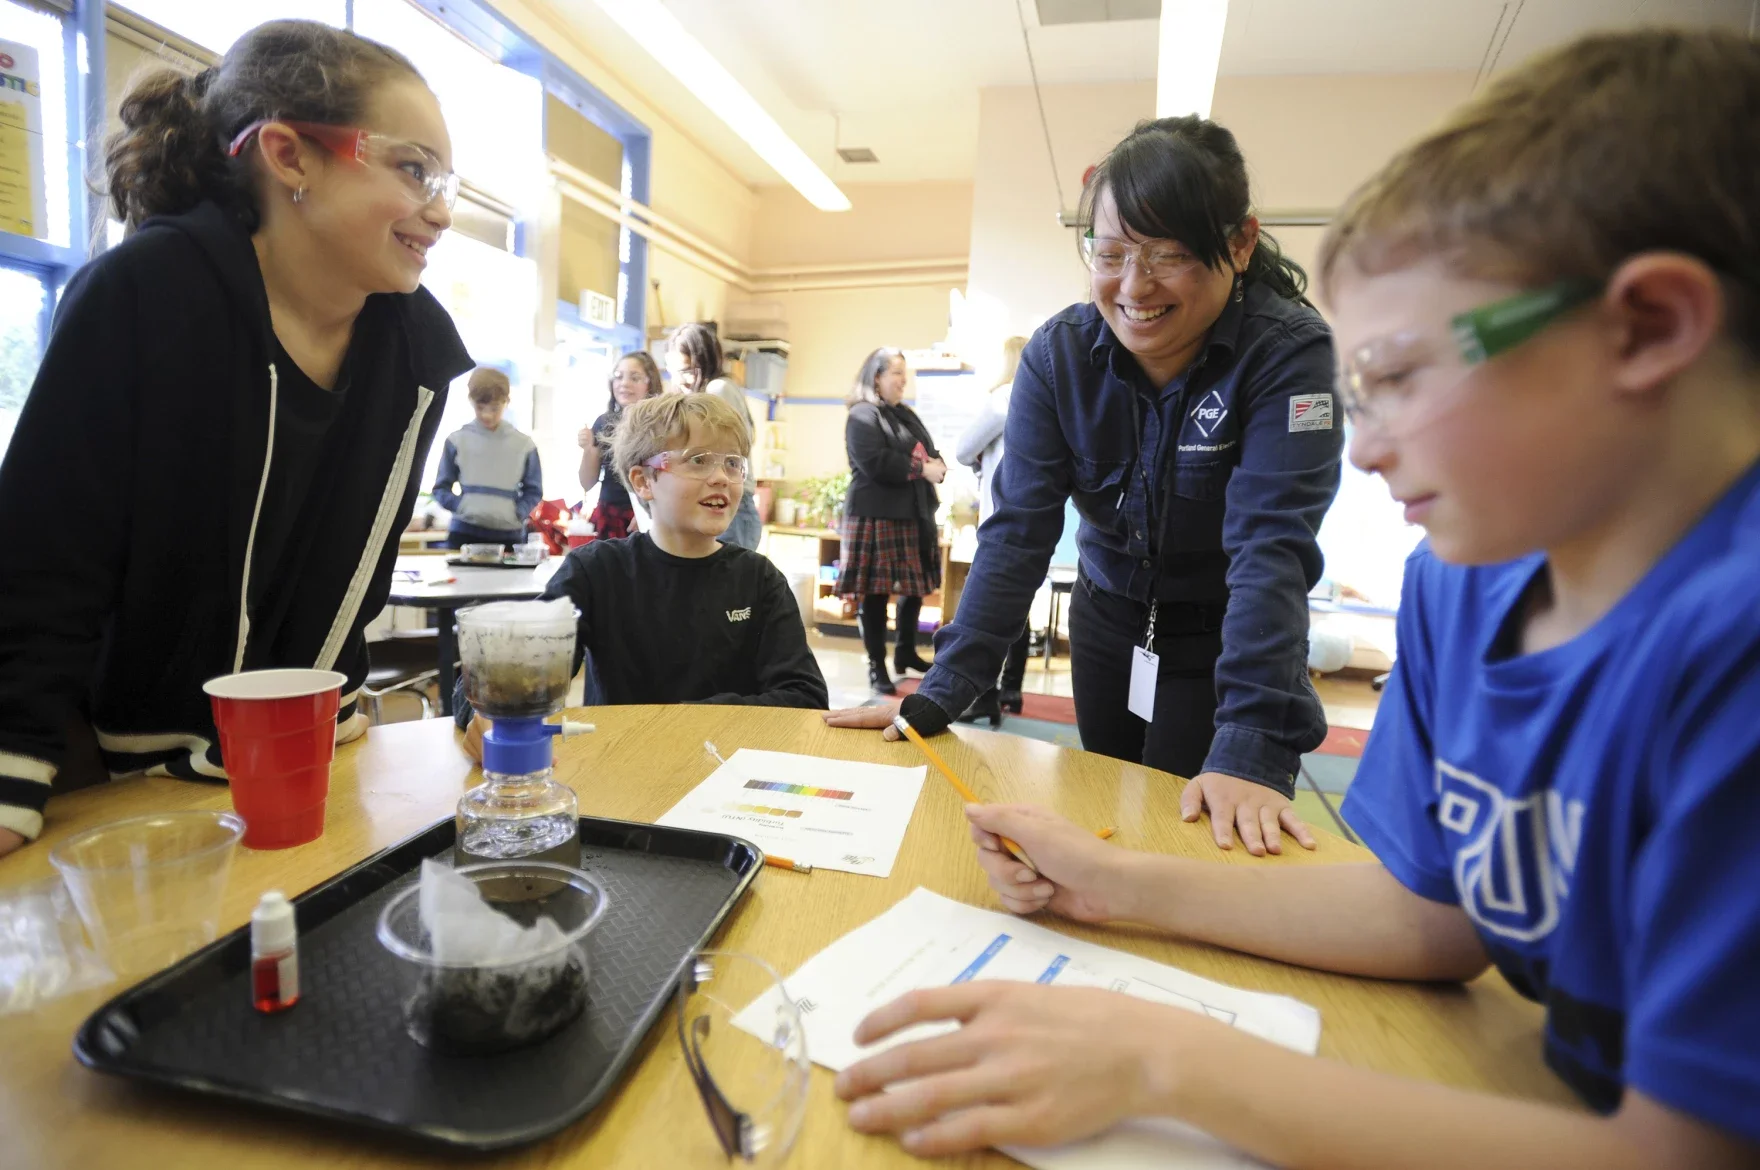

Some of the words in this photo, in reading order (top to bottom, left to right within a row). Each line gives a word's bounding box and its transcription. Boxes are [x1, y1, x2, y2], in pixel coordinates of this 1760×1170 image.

[1199, 408, 1220, 420] PGE
[1178, 444, 1197, 452] Portland
[1197, 444, 1218, 452] General
[726, 607, 751, 622] VANS
[748, 817, 785, 827] Turbidity
